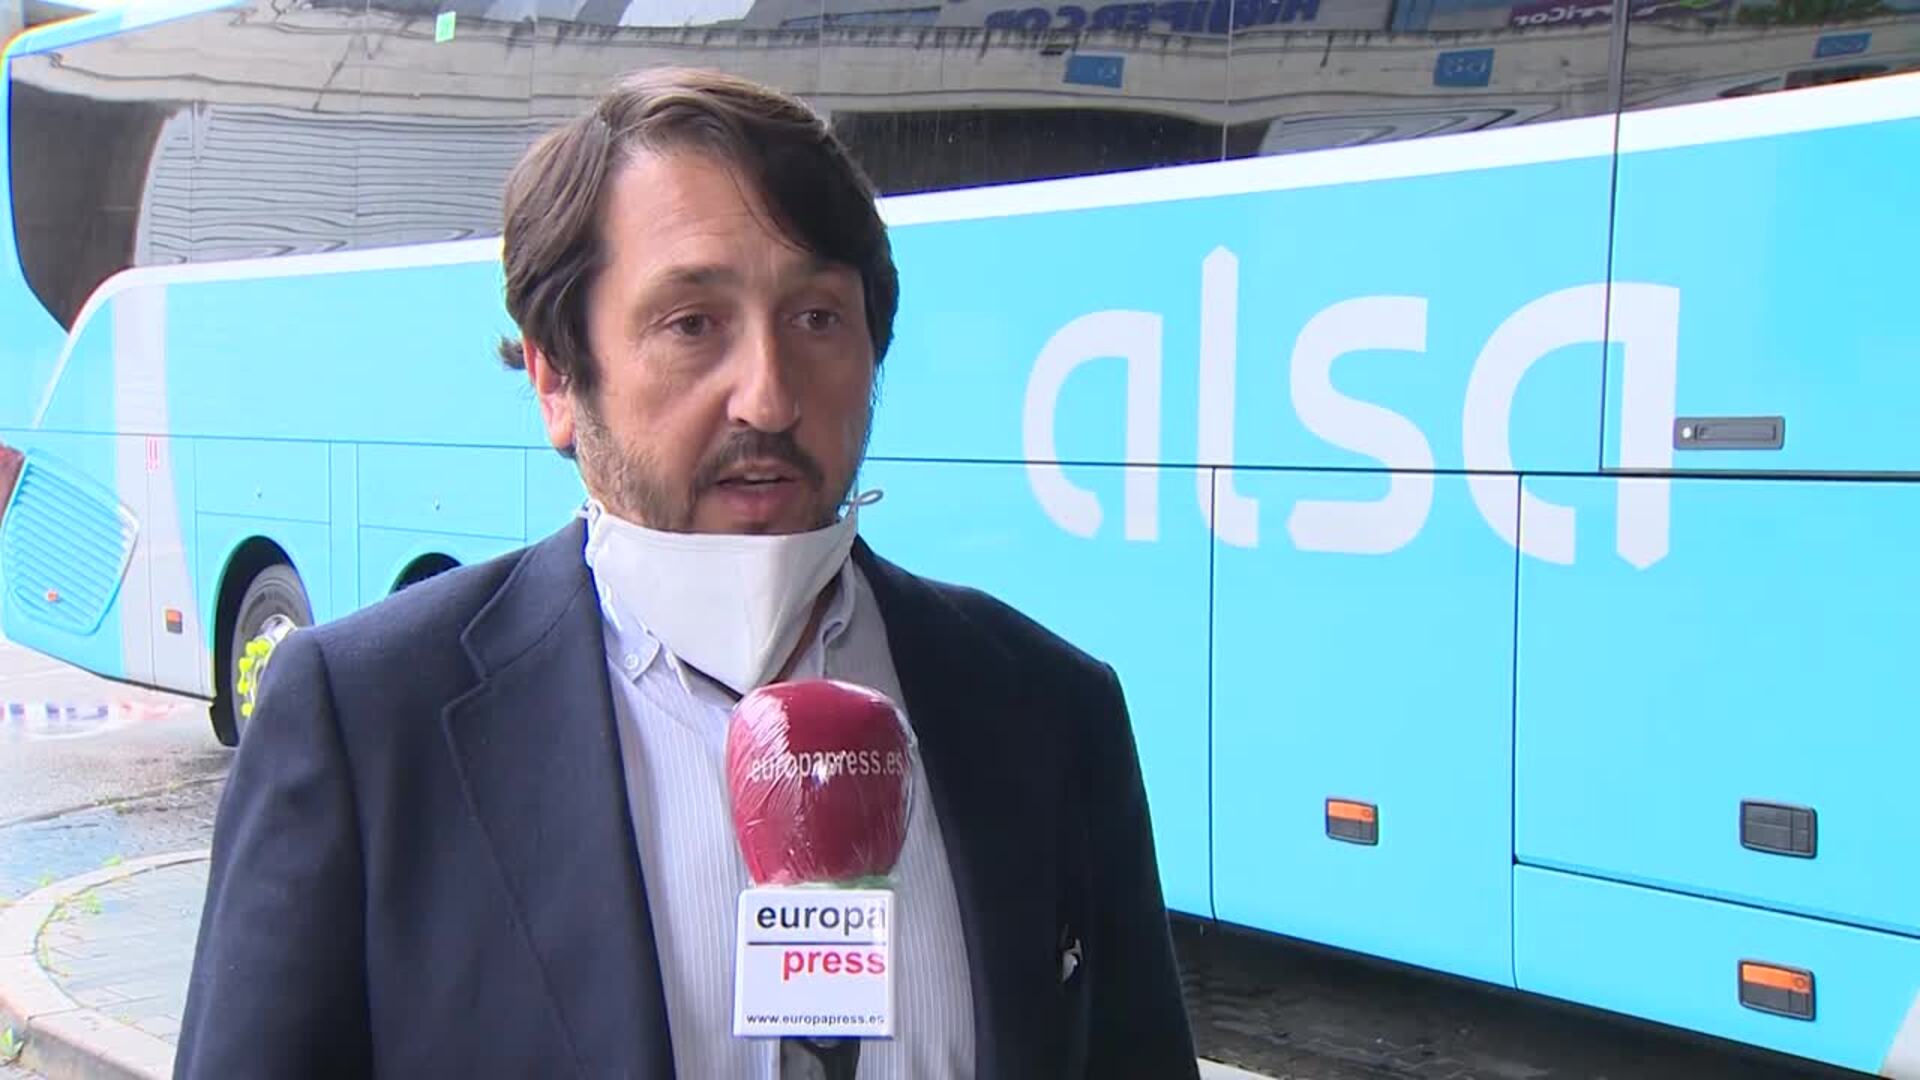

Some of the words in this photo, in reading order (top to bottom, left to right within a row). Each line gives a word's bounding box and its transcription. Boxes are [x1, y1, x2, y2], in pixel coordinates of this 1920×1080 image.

[1022, 244, 1680, 570] alsa
[750, 750, 903, 782] europapress.es
[757, 905, 886, 937] europa
[783, 950, 886, 981] press
[747, 1013, 885, 1027] www.europapress.es
